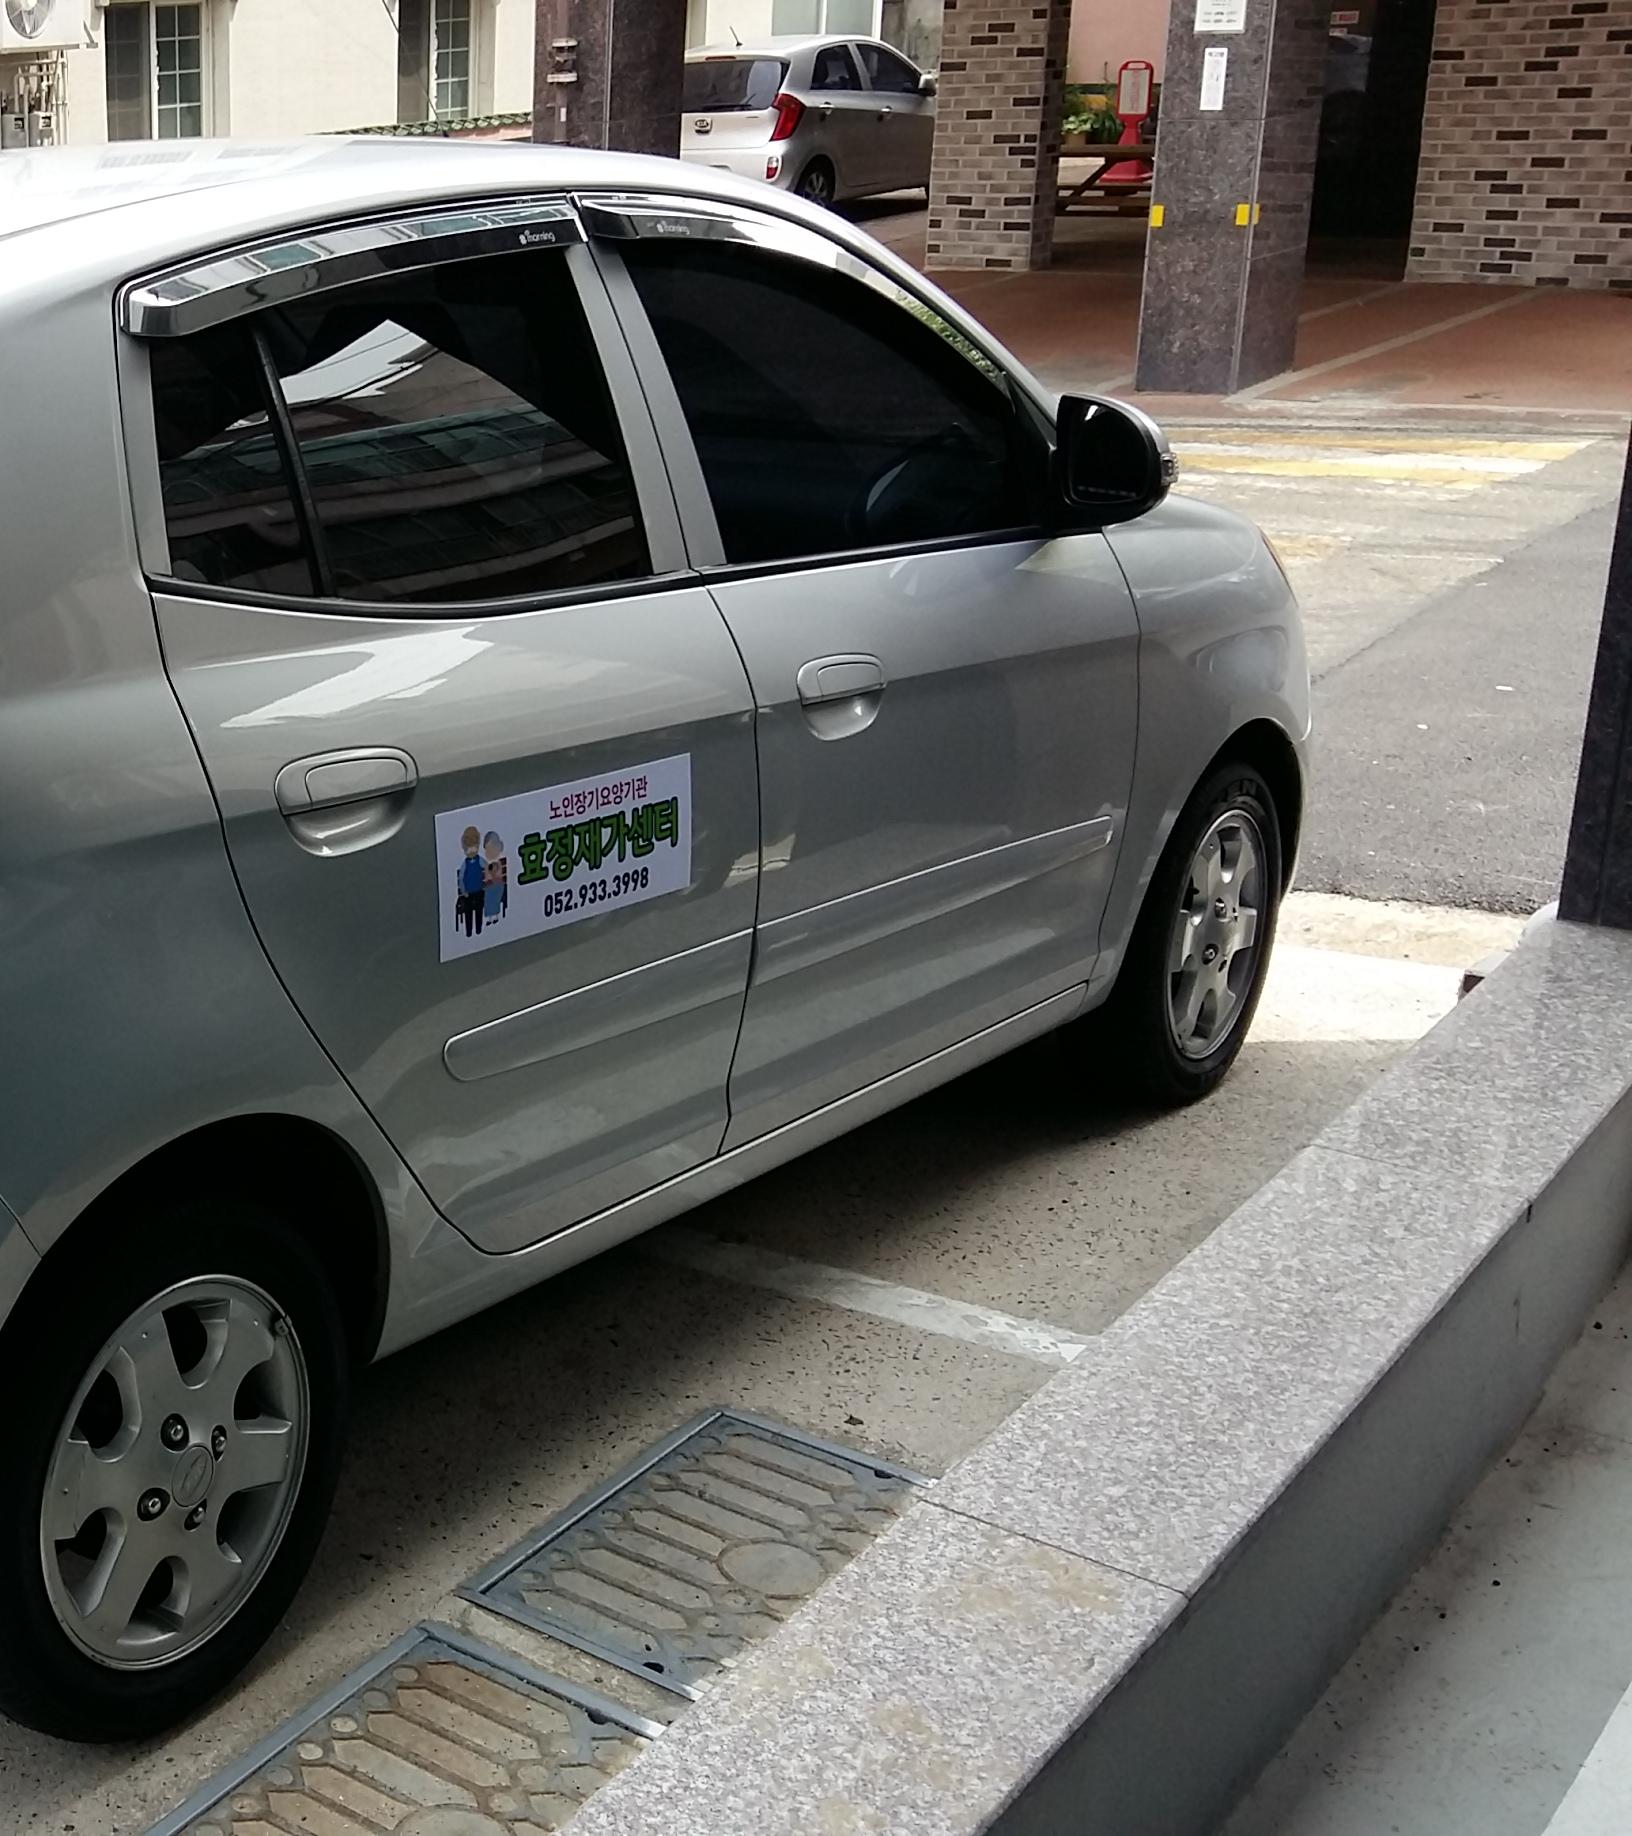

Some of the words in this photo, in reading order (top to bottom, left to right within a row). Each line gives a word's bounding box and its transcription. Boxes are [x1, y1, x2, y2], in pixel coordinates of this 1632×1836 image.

[549, 775, 648, 820] 노인장기요양기관
[517, 796, 679, 886] 효정재가센터
[543, 866, 650, 917] 052.933.3998
